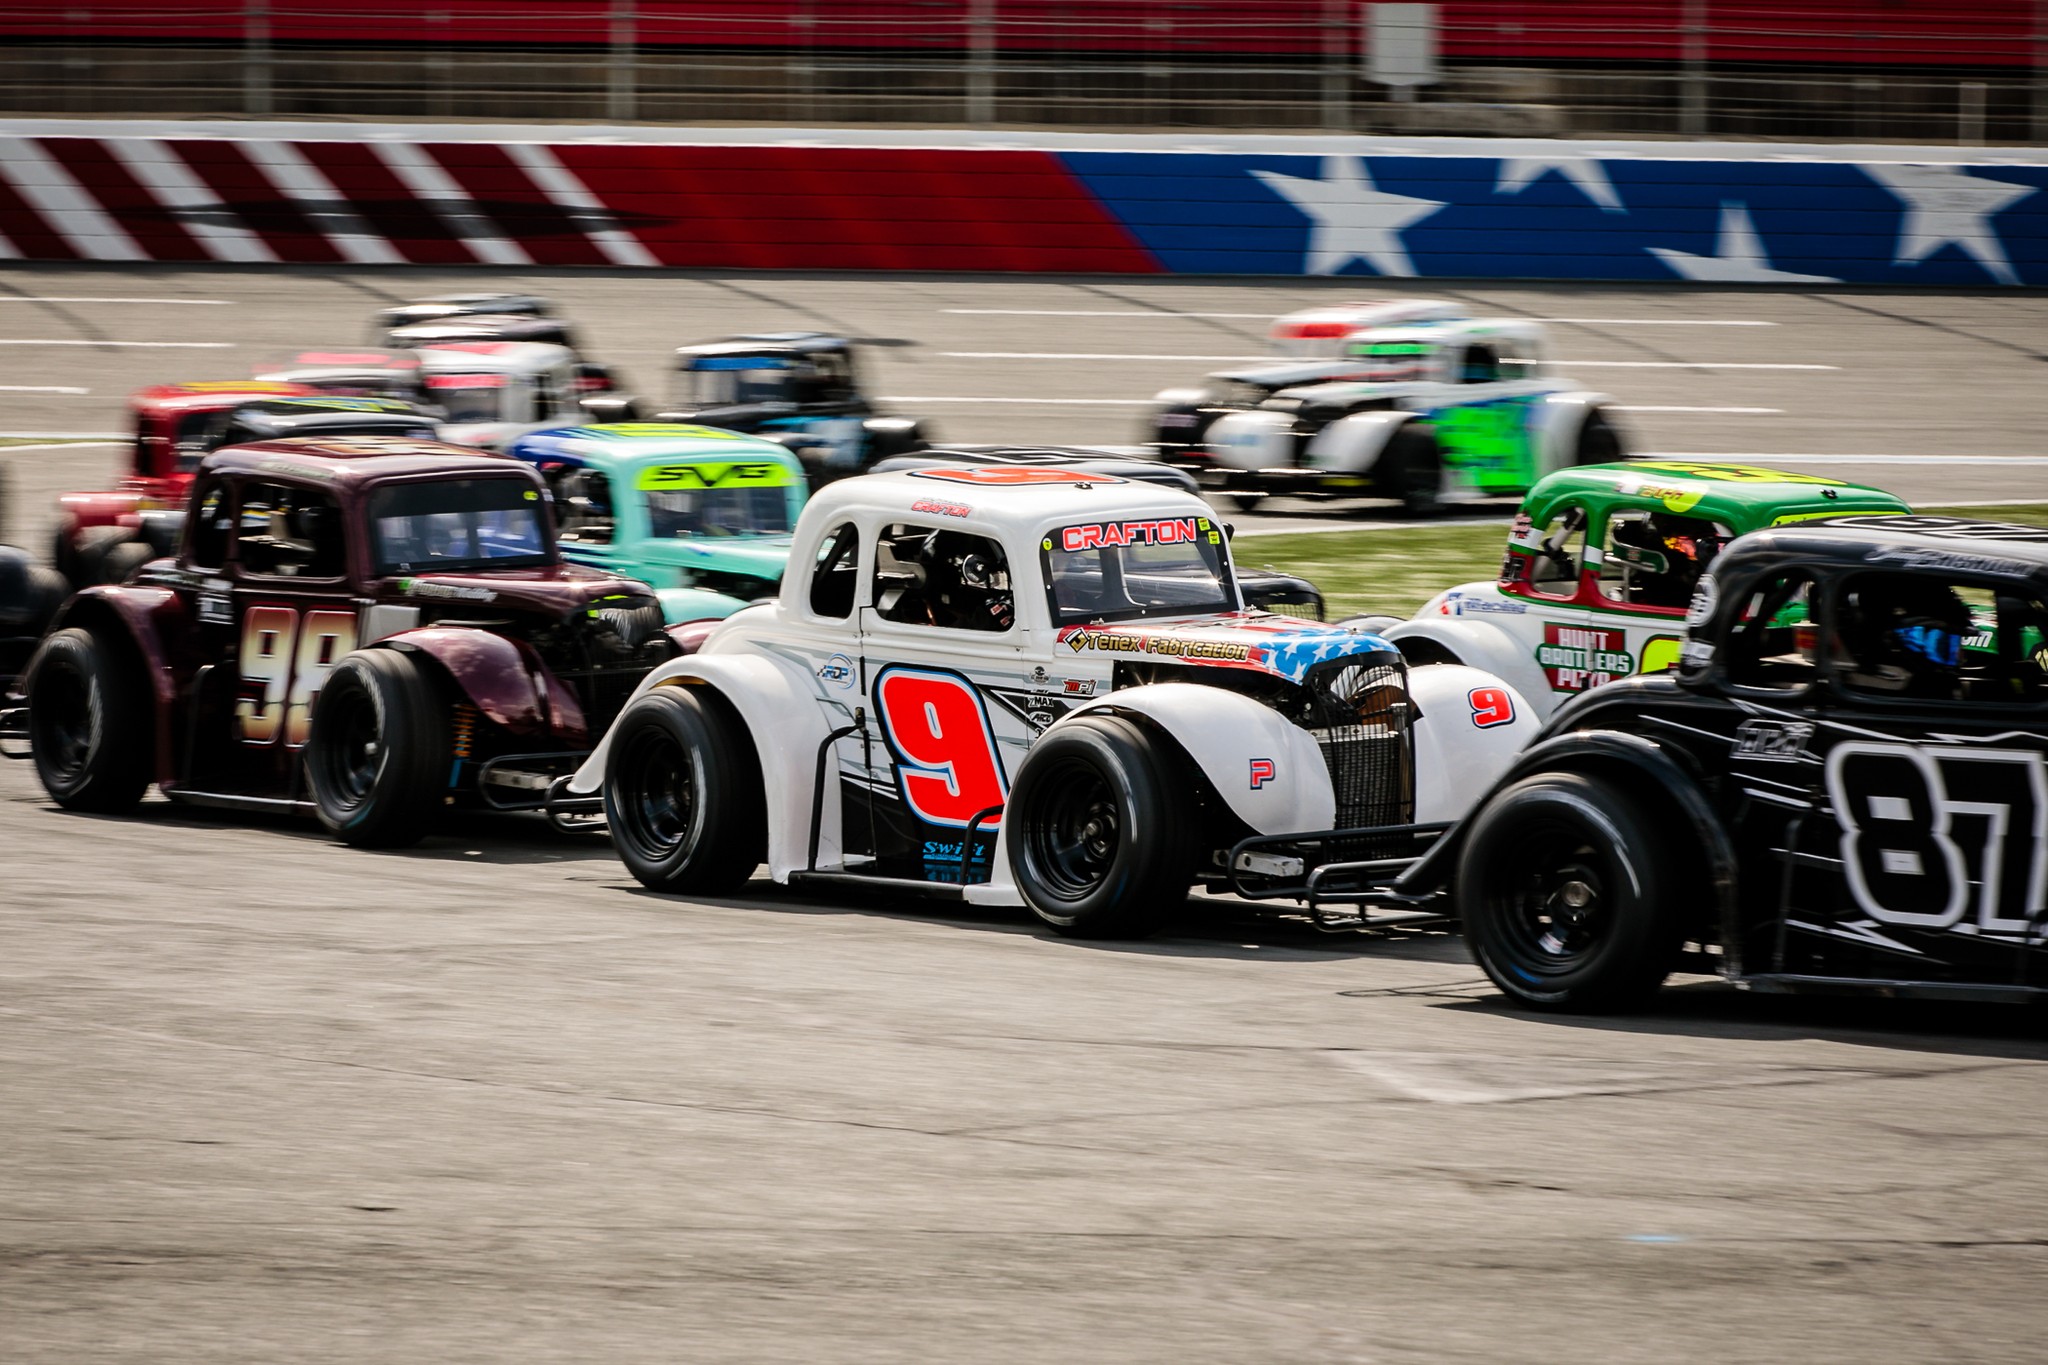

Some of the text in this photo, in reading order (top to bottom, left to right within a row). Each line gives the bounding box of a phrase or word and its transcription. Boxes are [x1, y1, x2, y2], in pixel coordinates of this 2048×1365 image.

[911, 501, 972, 518] CRAFTON
[1063, 519, 1196, 552] CRAFTON
[1088, 632, 1250, 660] Tenex Fabrication
[1540, 647, 1630, 673] BROTERS
[234, 606, 358, 747] 98
[1468, 686, 1516, 729] 9
[872, 662, 1006, 833] 9
[1250, 758, 1276, 790] P
[922, 841, 985, 856] Swit
[1824, 740, 2048, 934] 87
